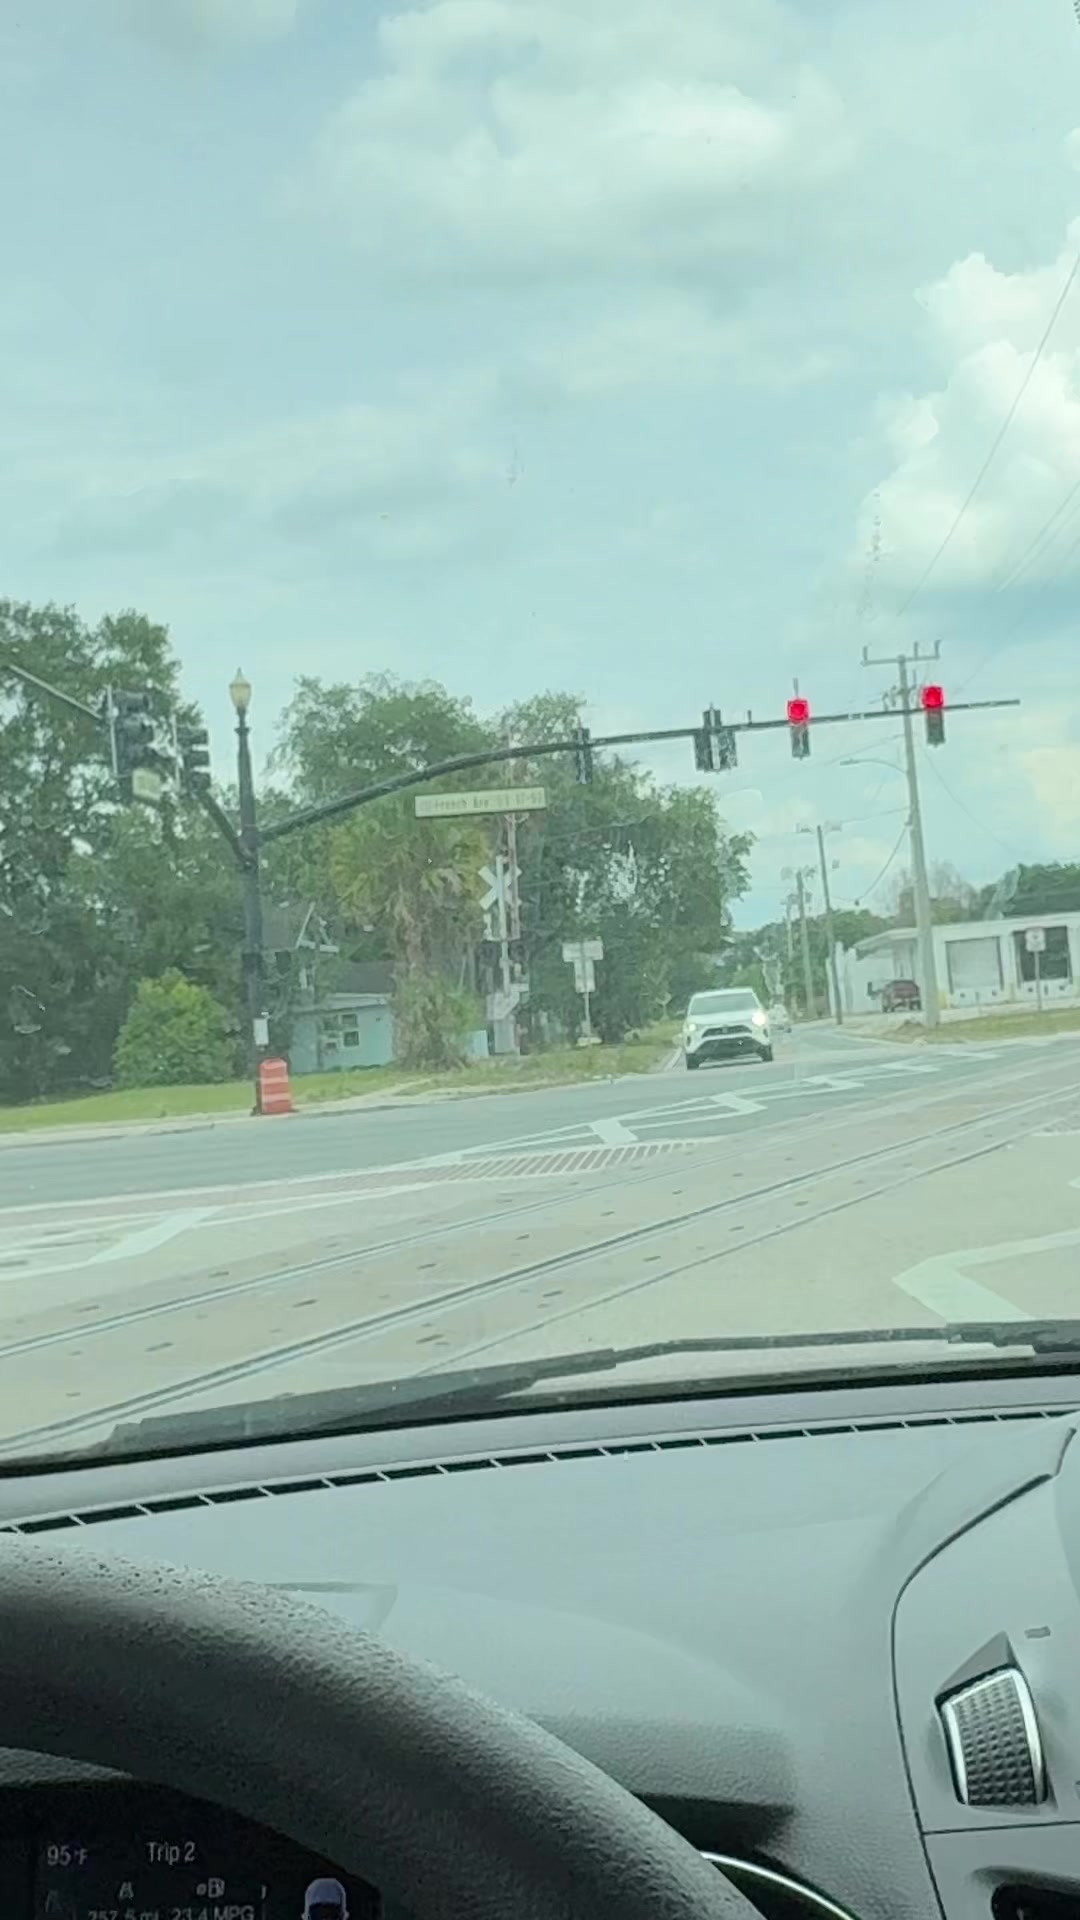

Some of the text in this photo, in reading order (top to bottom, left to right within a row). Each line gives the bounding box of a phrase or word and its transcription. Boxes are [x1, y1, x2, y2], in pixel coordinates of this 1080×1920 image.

[145, 1841, 197, 1866] Trip 2
[171, 1904, 255, 1920] 234 MPG
